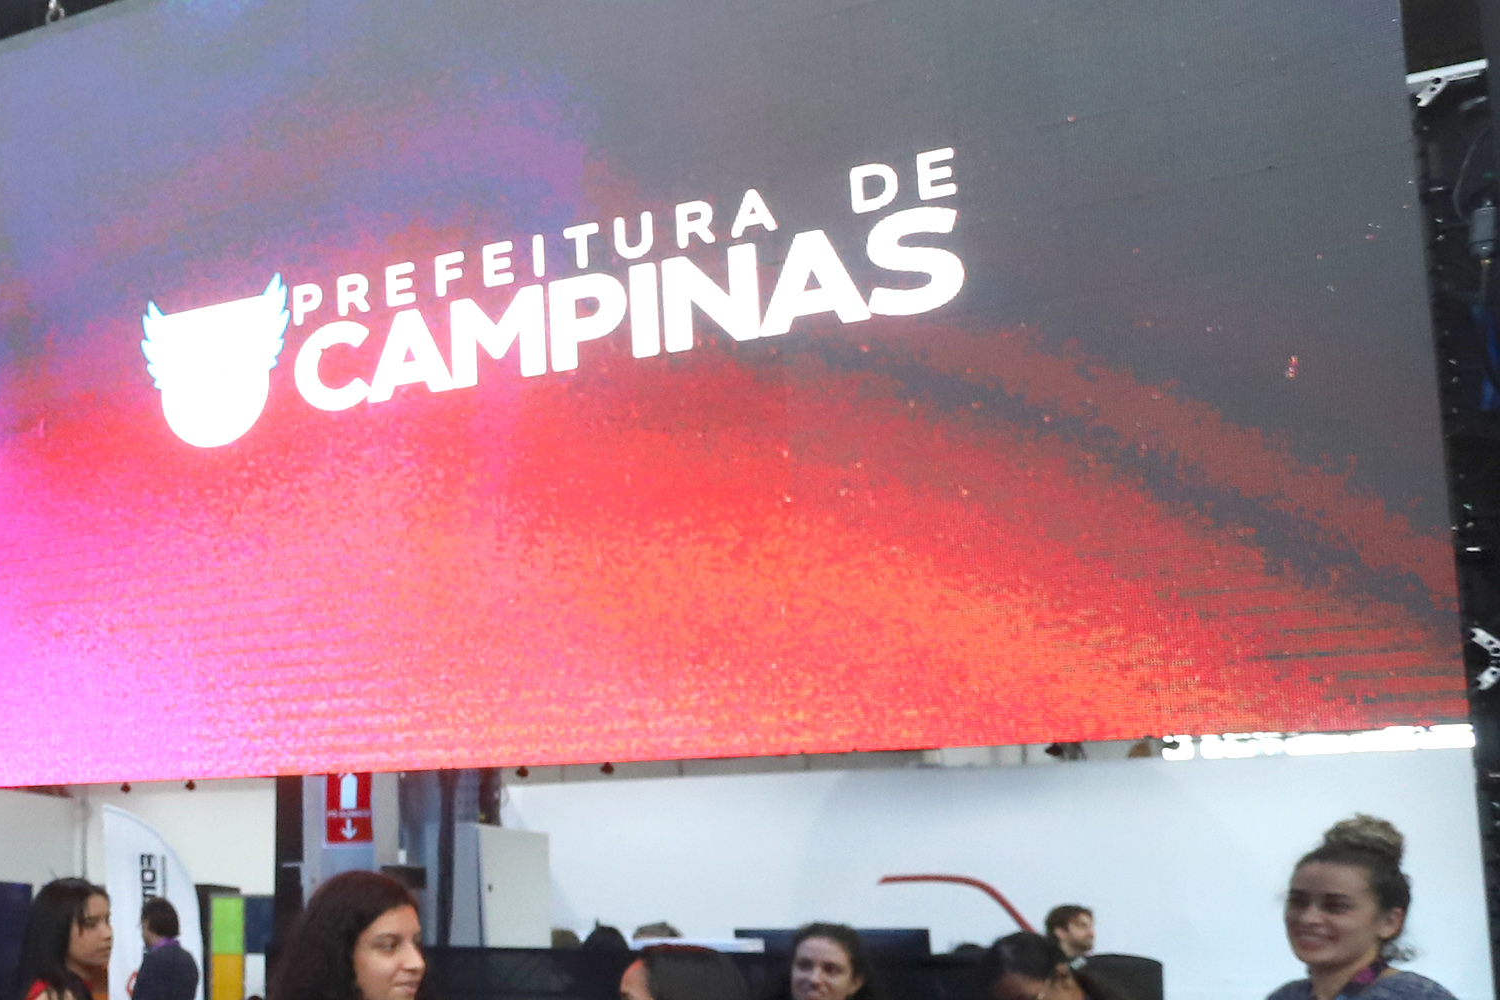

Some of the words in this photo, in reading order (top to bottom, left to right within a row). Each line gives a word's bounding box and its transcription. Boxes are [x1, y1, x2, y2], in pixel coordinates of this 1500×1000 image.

[292, 188, 778, 326] PREFEITURA
[848, 146, 958, 215] DE
[293, 205, 966, 412] CAMPINAS
